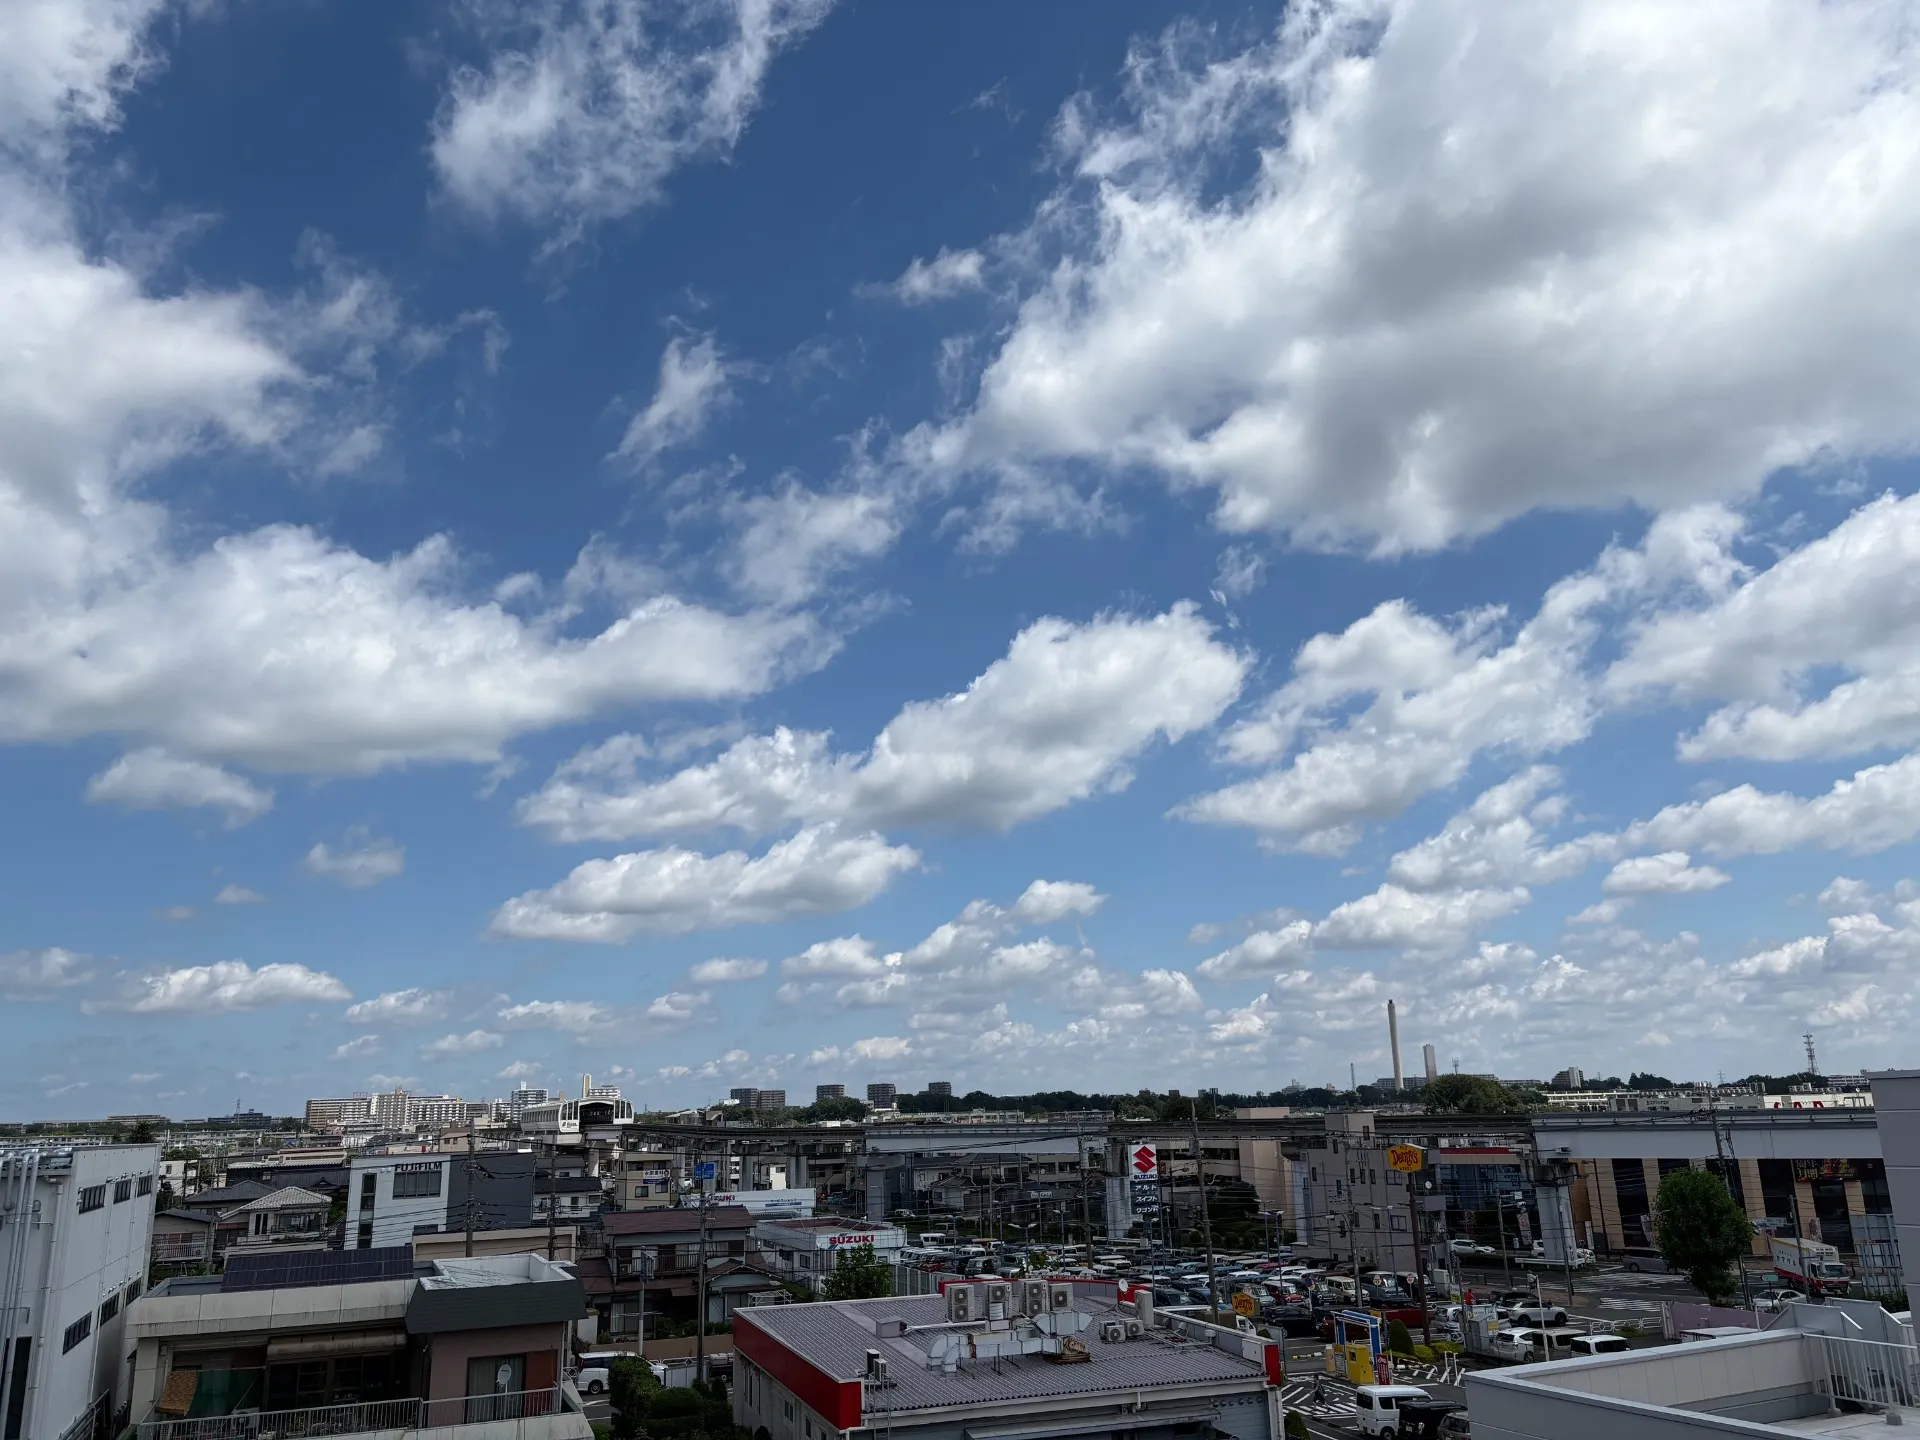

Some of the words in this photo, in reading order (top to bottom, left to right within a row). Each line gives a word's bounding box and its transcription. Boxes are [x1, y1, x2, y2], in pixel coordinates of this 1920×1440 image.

[1390, 1149, 1418, 1167] Denny's
[395, 1161, 442, 1172] FUJIFILM
[1136, 1195, 1158, 1203] スイフト
[829, 1234, 875, 1245] SUZUKI
